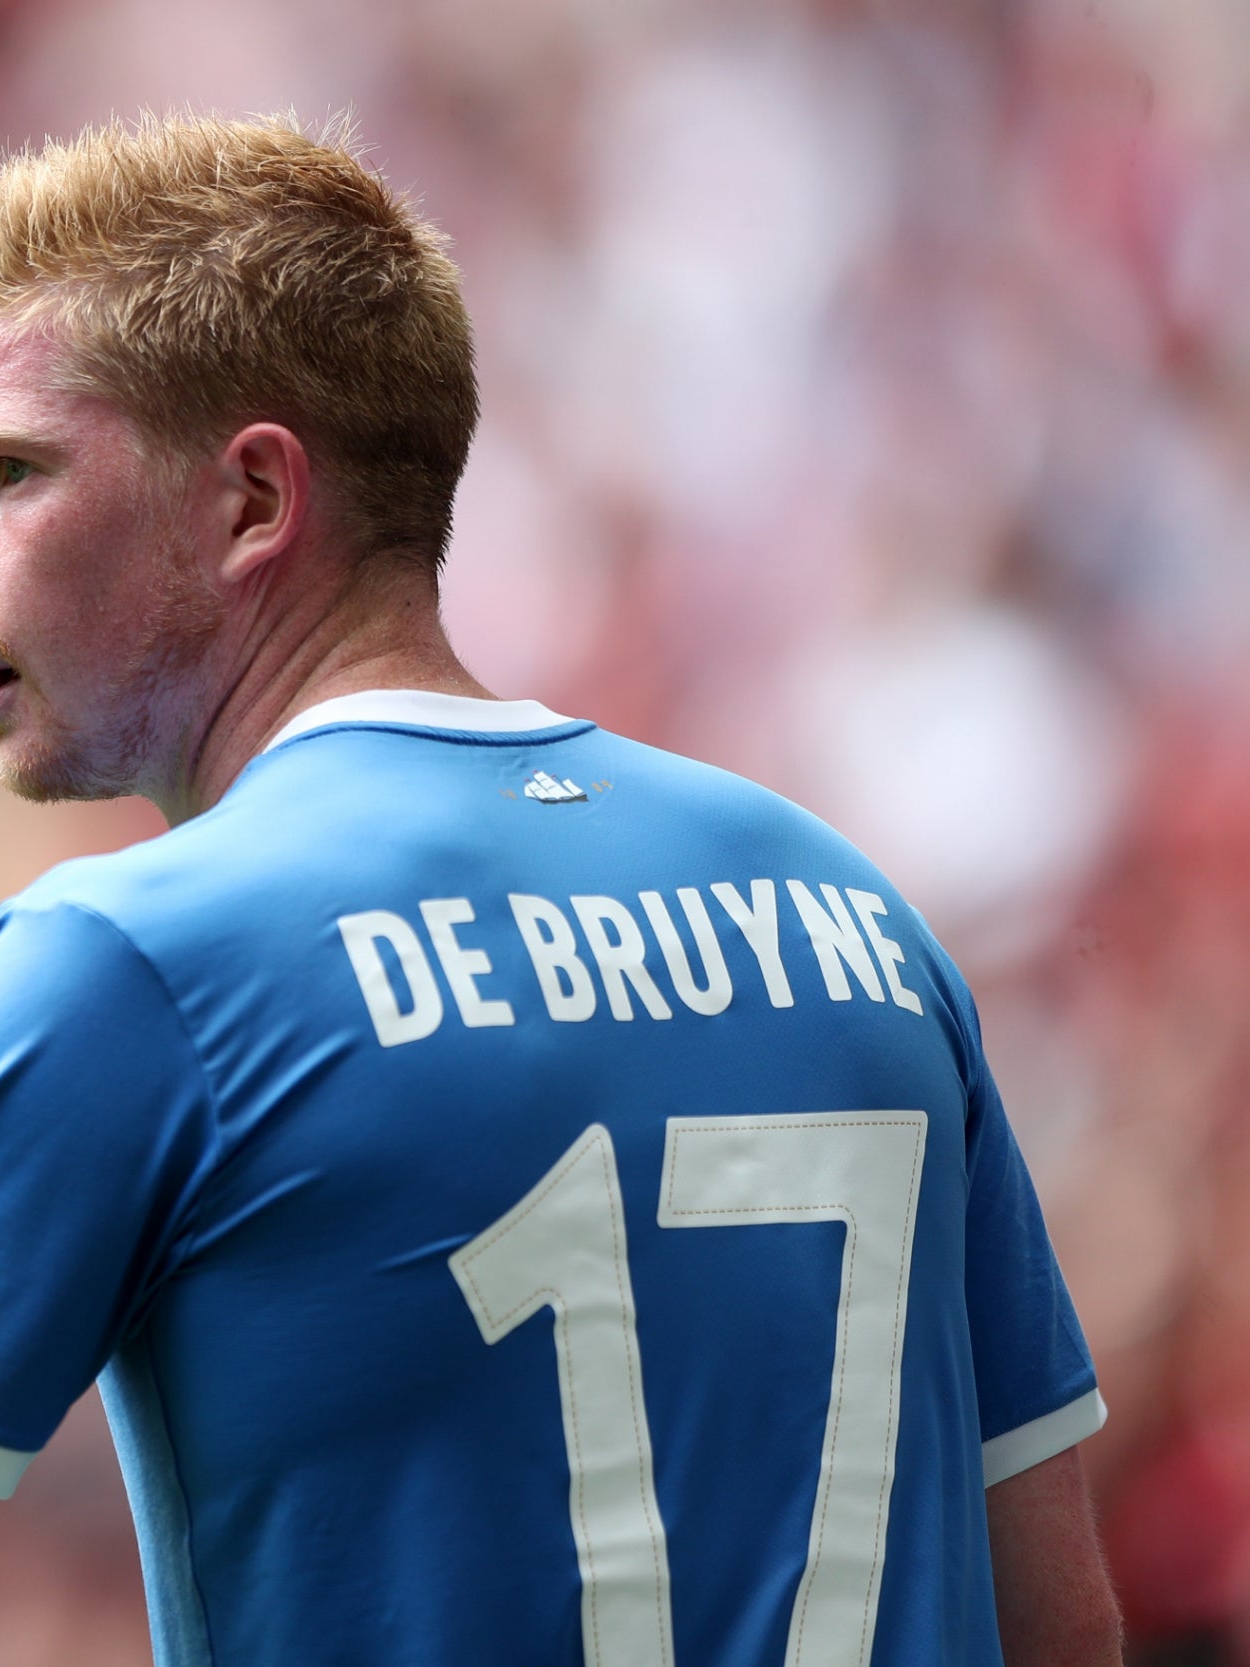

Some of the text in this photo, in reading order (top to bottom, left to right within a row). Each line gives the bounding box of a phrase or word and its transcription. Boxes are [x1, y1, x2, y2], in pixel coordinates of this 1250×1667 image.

[337, 879, 923, 1047] DE BRUYNE
[449, 1110, 928, 1667] 17
